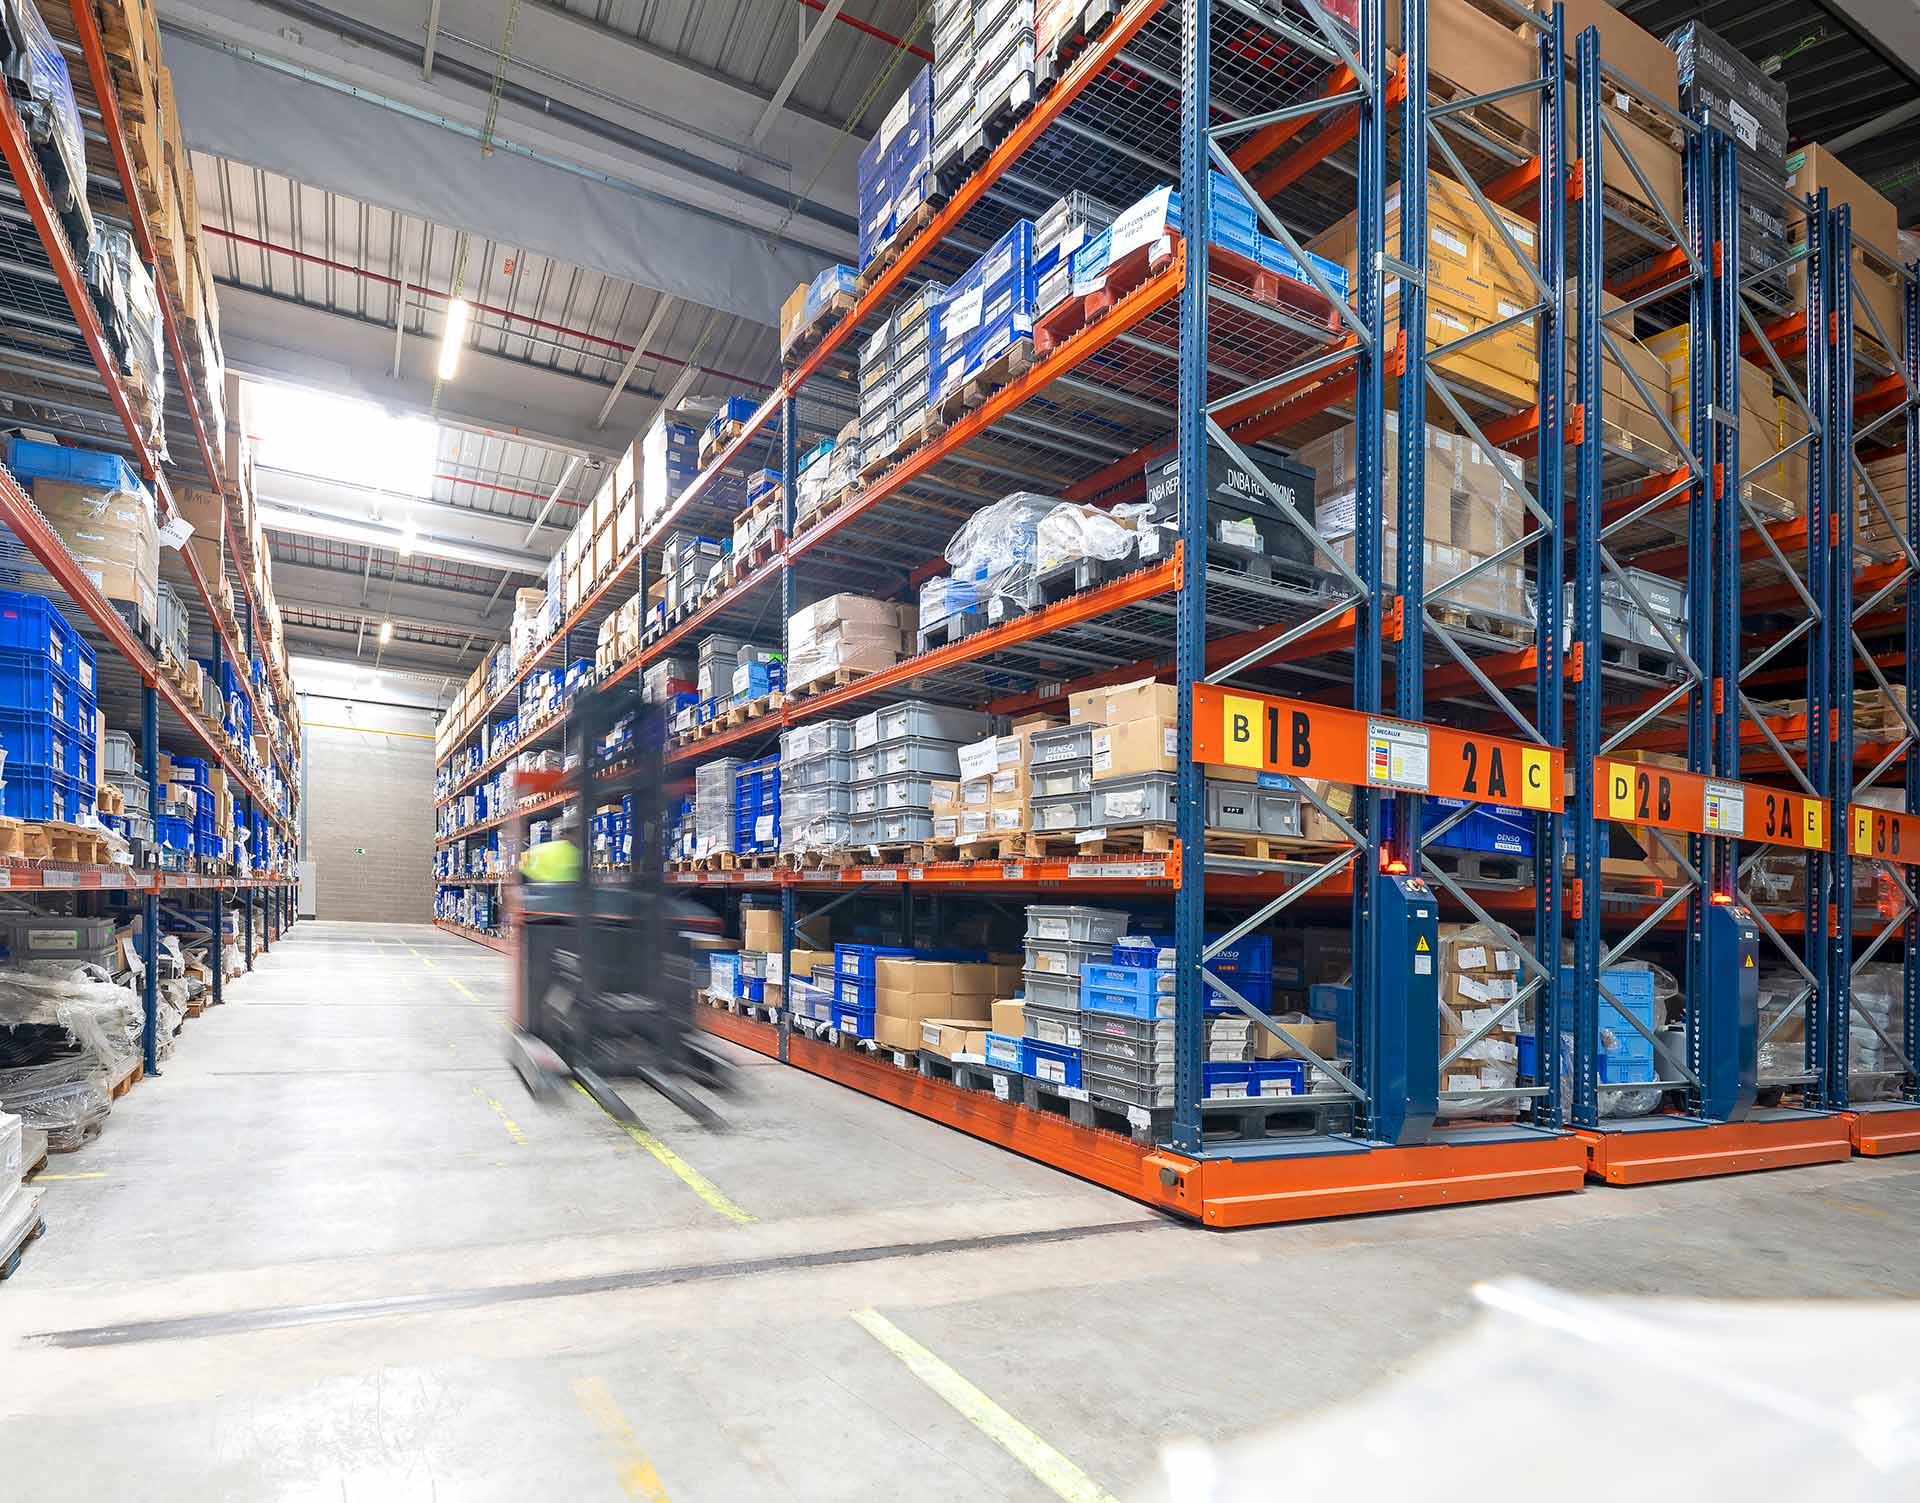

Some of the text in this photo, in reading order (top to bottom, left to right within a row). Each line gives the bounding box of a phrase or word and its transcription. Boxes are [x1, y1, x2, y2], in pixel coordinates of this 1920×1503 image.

[1233, 713, 1249, 742] B
[1268, 706, 1311, 768] 1B
[1047, 743, 1074, 754] DENSO
[1462, 741, 1507, 797] 2A
[1528, 764, 1541, 788] C
[1615, 776, 1628, 800] D
[1638, 772, 1670, 821] 2B
[1765, 793, 1793, 839] 3A
[1807, 811, 1815, 831] E
[1496, 833, 1520, 843] DENSO
[1858, 819, 1865, 839] F
